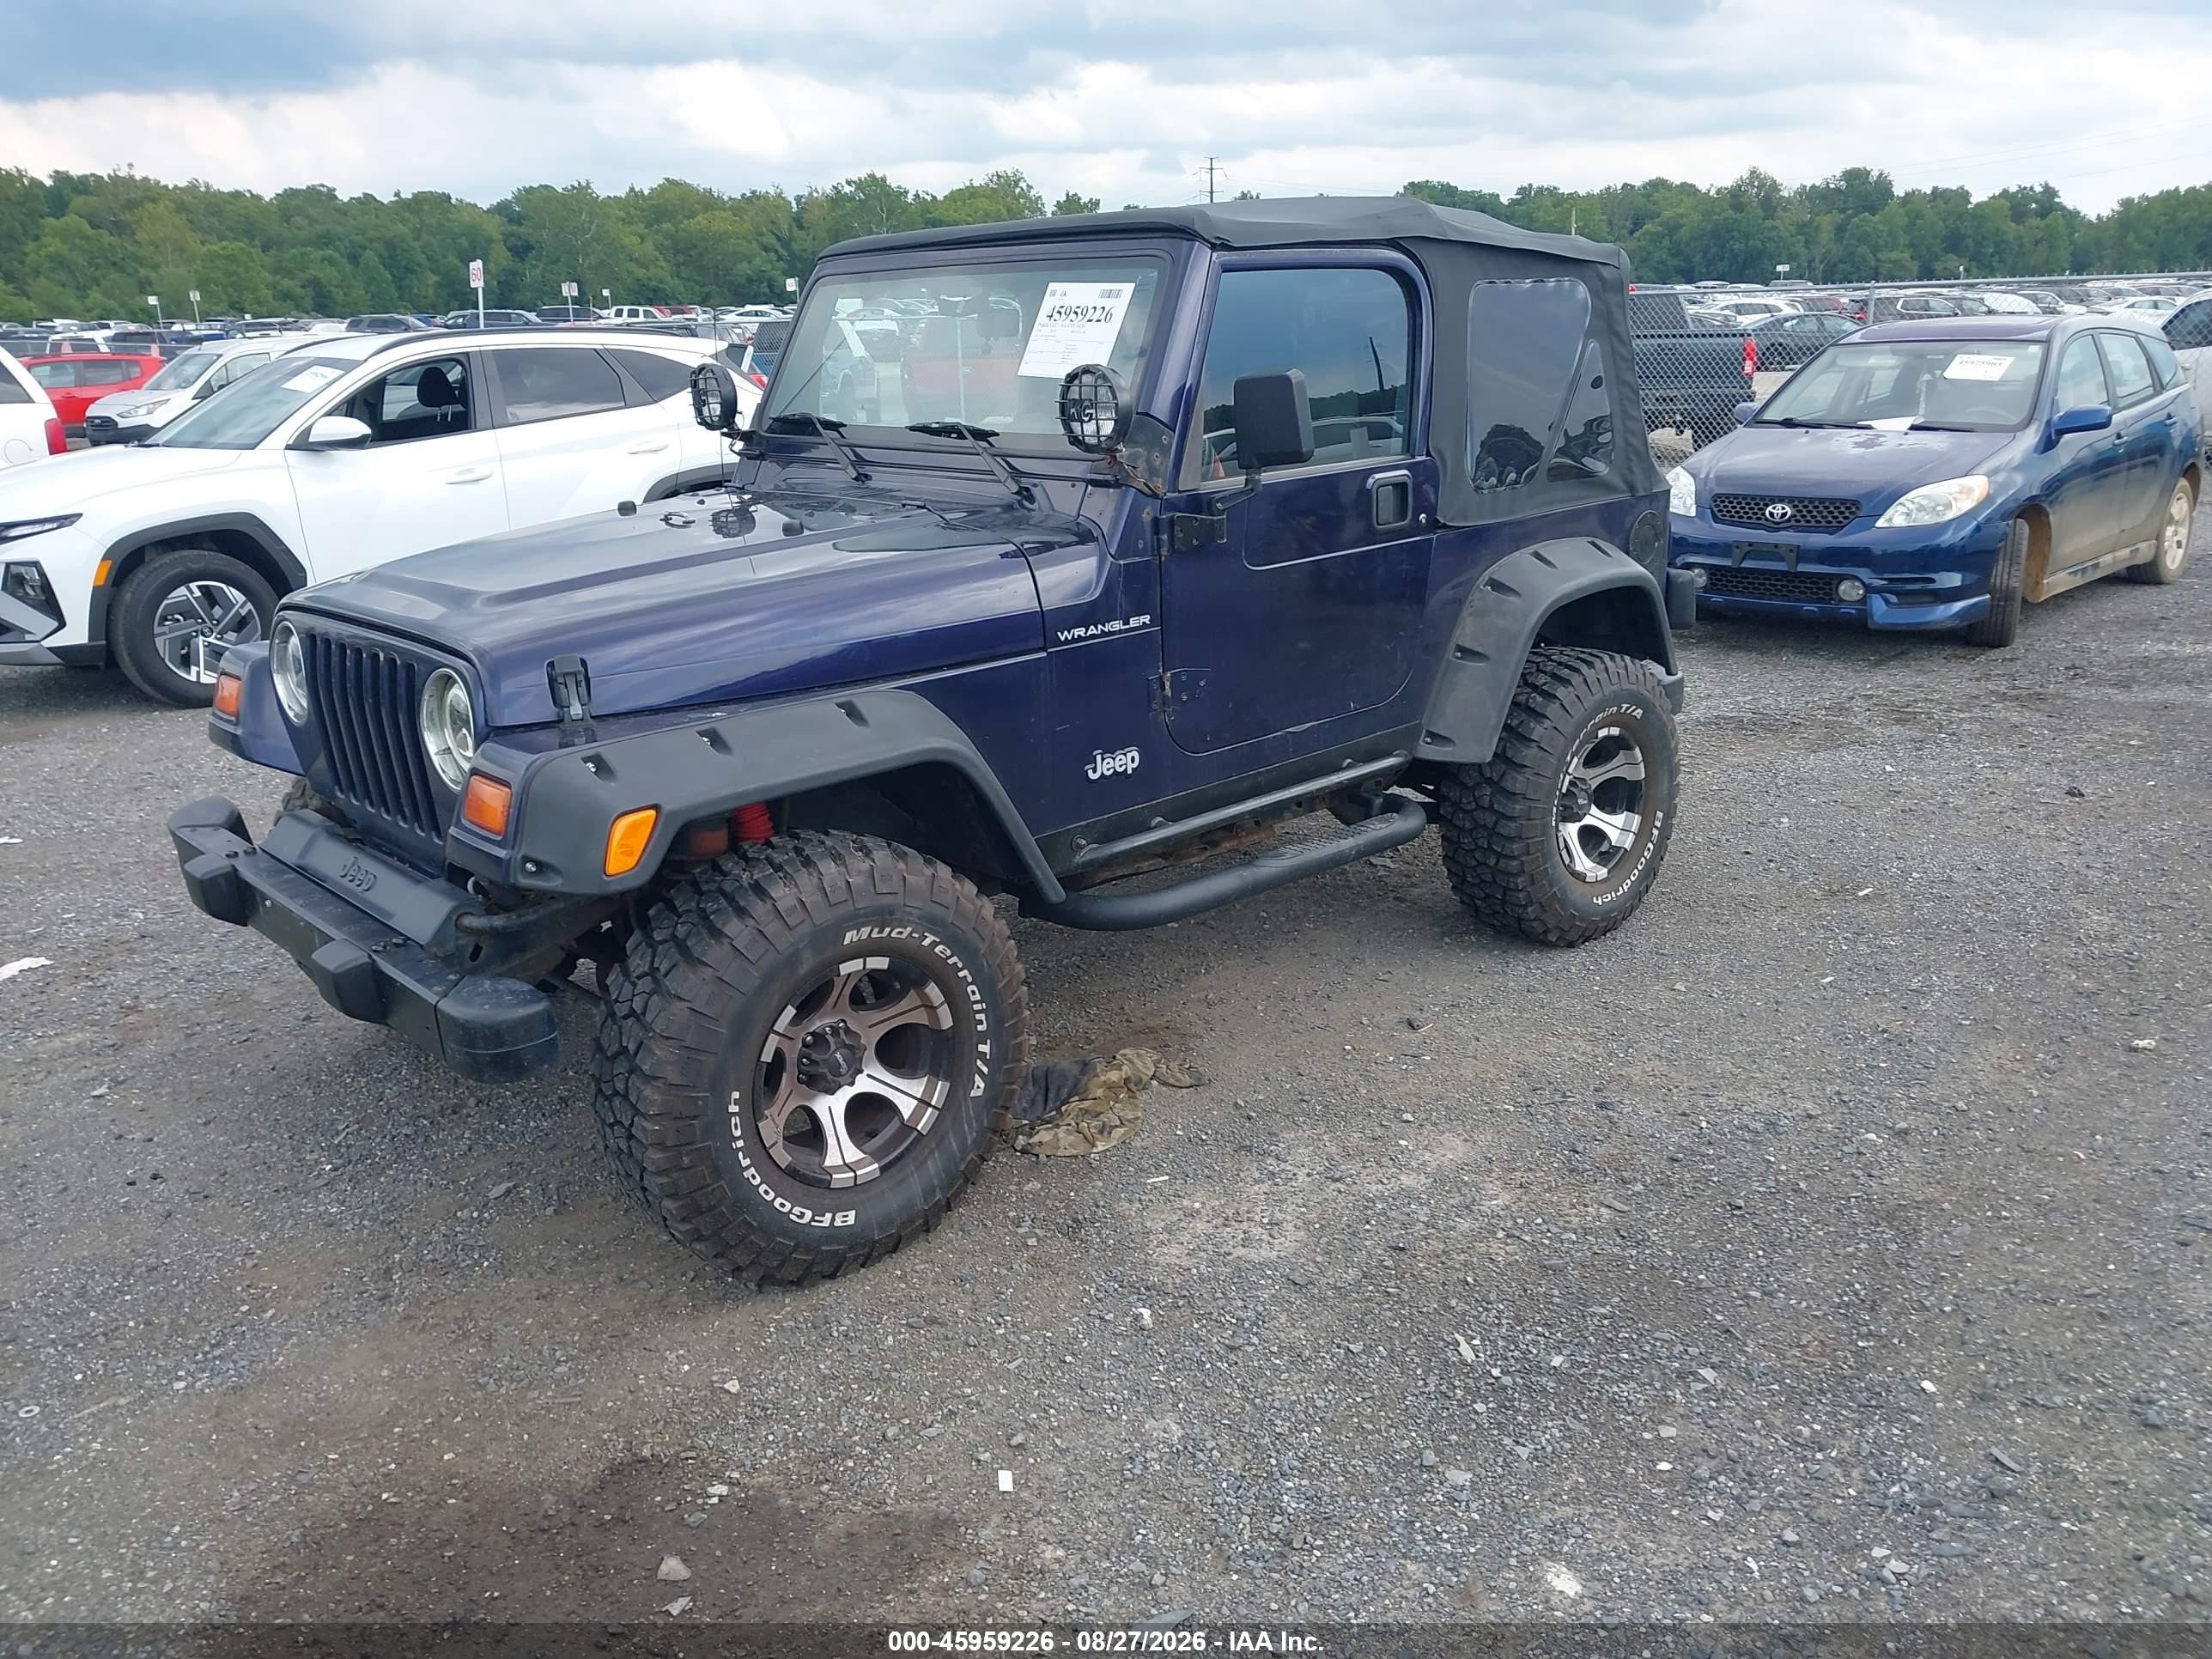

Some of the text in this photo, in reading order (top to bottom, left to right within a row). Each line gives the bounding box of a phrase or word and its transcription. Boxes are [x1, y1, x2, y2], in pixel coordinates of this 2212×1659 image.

[471, 267, 482, 282] 60
[1046, 304, 1115, 324] 45959226
[1057, 614, 1151, 641] WRANGLER
[1085, 747, 1140, 781] Jeep
[339, 856, 378, 894] Jeep
[1593, 810, 1664, 907] BFGoodrich
[842, 924, 992, 1098] Mud-Terrain T/A
[727, 1090, 857, 1228] BFGoodrich
